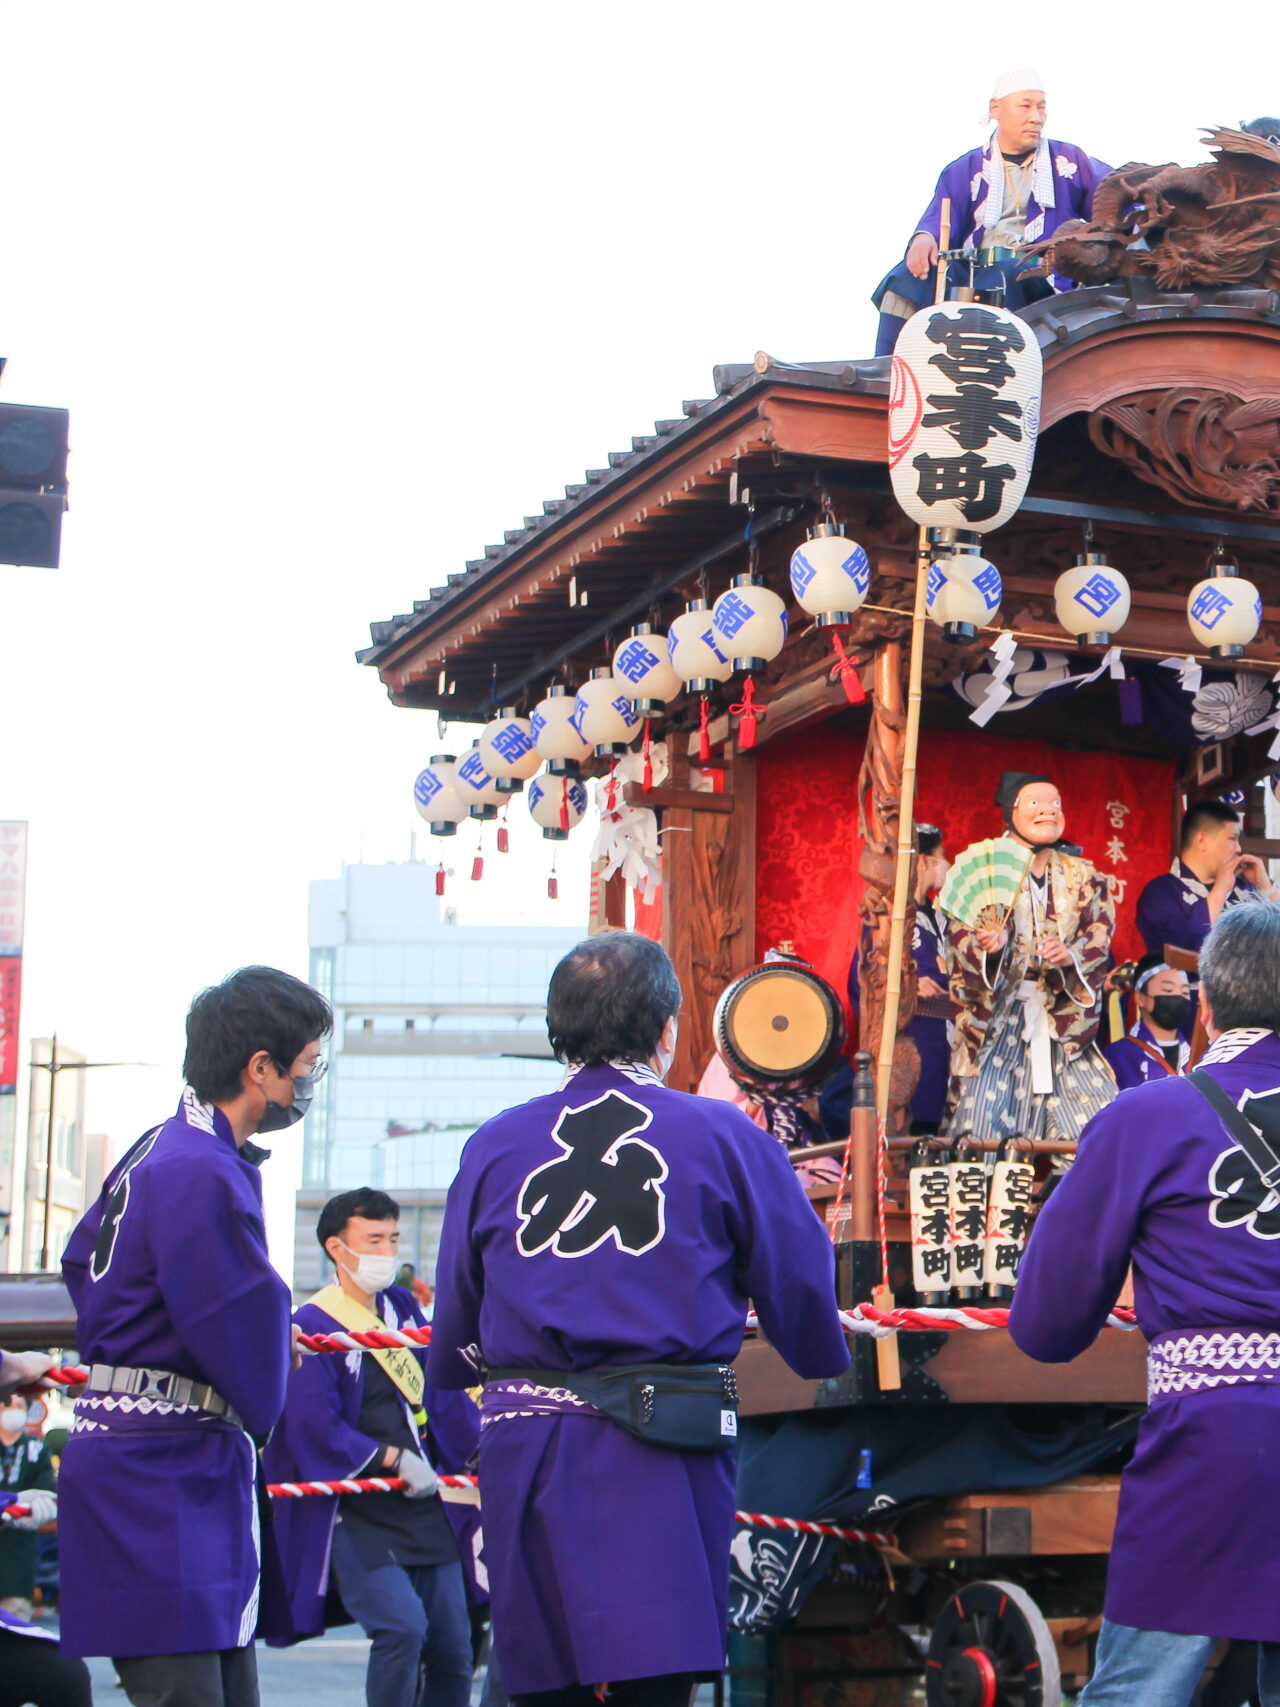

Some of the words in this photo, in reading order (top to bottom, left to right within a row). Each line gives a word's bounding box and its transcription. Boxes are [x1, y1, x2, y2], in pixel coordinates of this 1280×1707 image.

[912, 307, 1026, 523] 宮本町
[919, 1171, 951, 1283] 宮本町
[953, 1166, 987, 1281] 宮本町
[995, 1168, 1035, 1279] 宮本町
